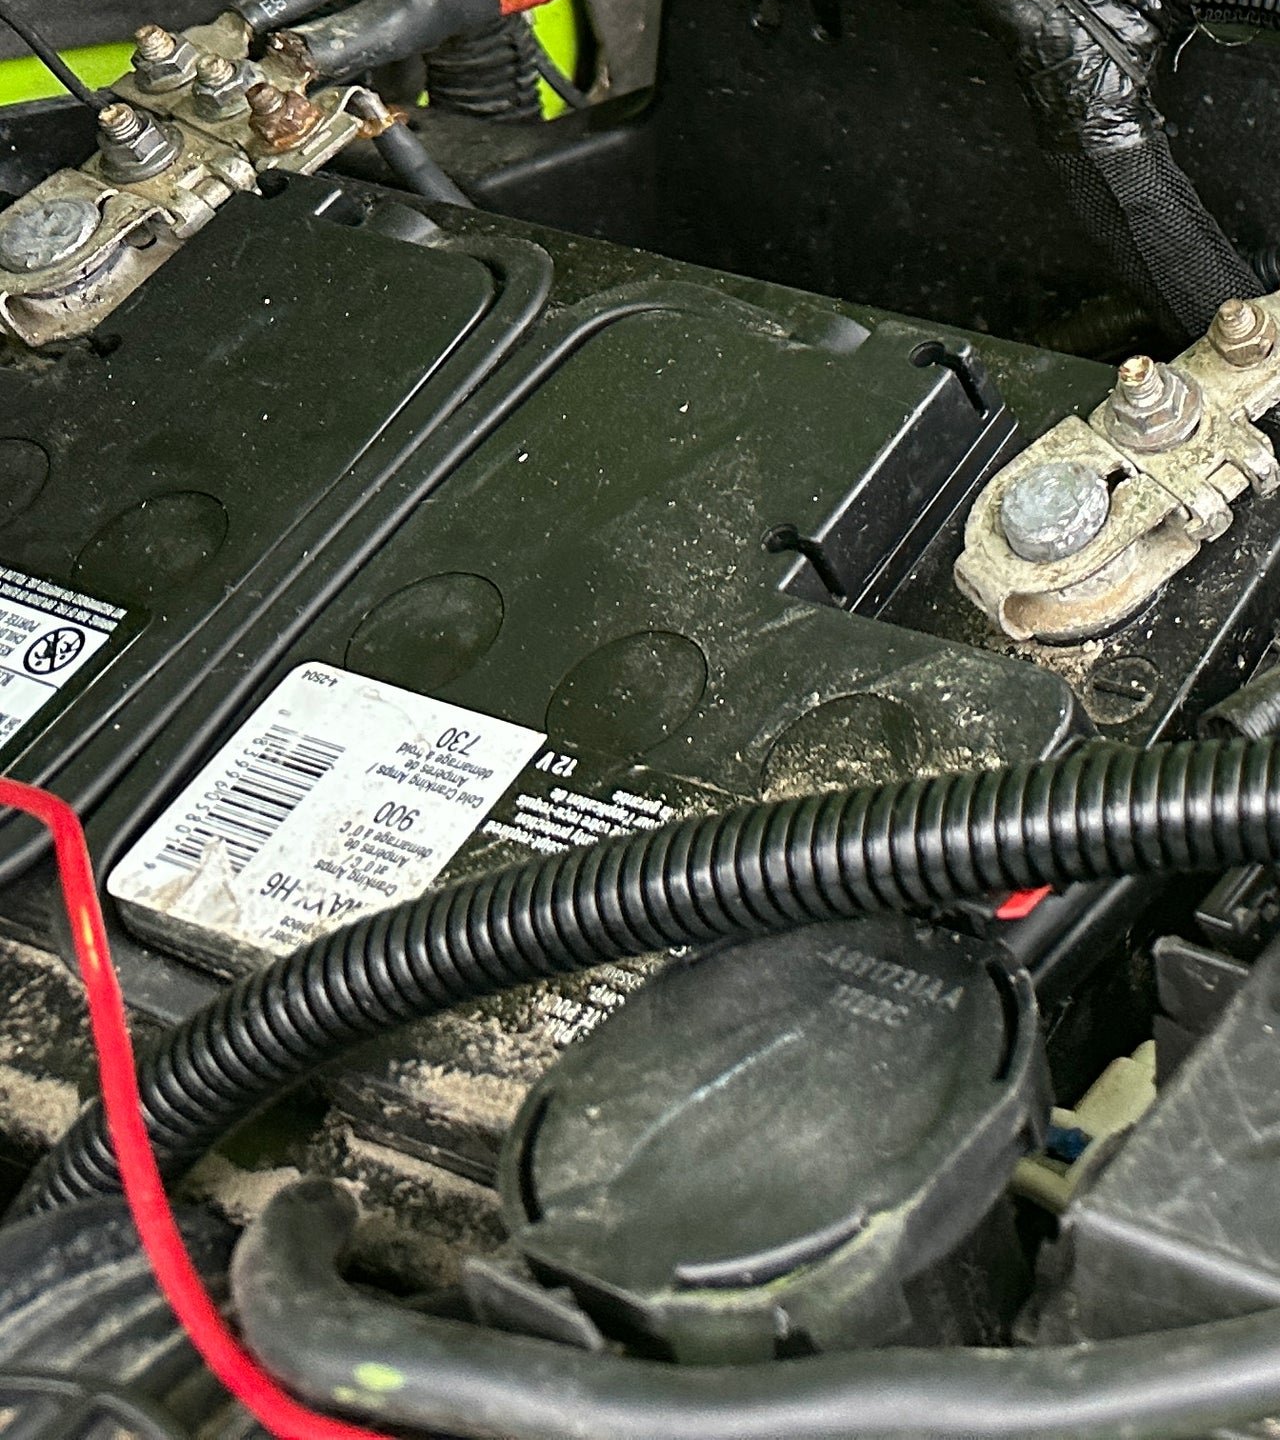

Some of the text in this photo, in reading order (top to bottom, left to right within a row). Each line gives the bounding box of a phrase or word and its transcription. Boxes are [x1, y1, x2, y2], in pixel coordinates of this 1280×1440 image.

[436, 727, 481, 758] 730
[376, 765, 411, 785] Amps
[404, 759, 469, 789] Ampères de
[435, 753, 494, 781] démarrage
[408, 774, 458, 801] Cranking
[455, 791, 485, 809] Cold
[373, 801, 420, 832] 900
[344, 837, 411, 868] Ampères de
[373, 831, 433, 862] démarrage
[314, 858, 398, 897] Cranking Amps
[373, 864, 389, 875] at
